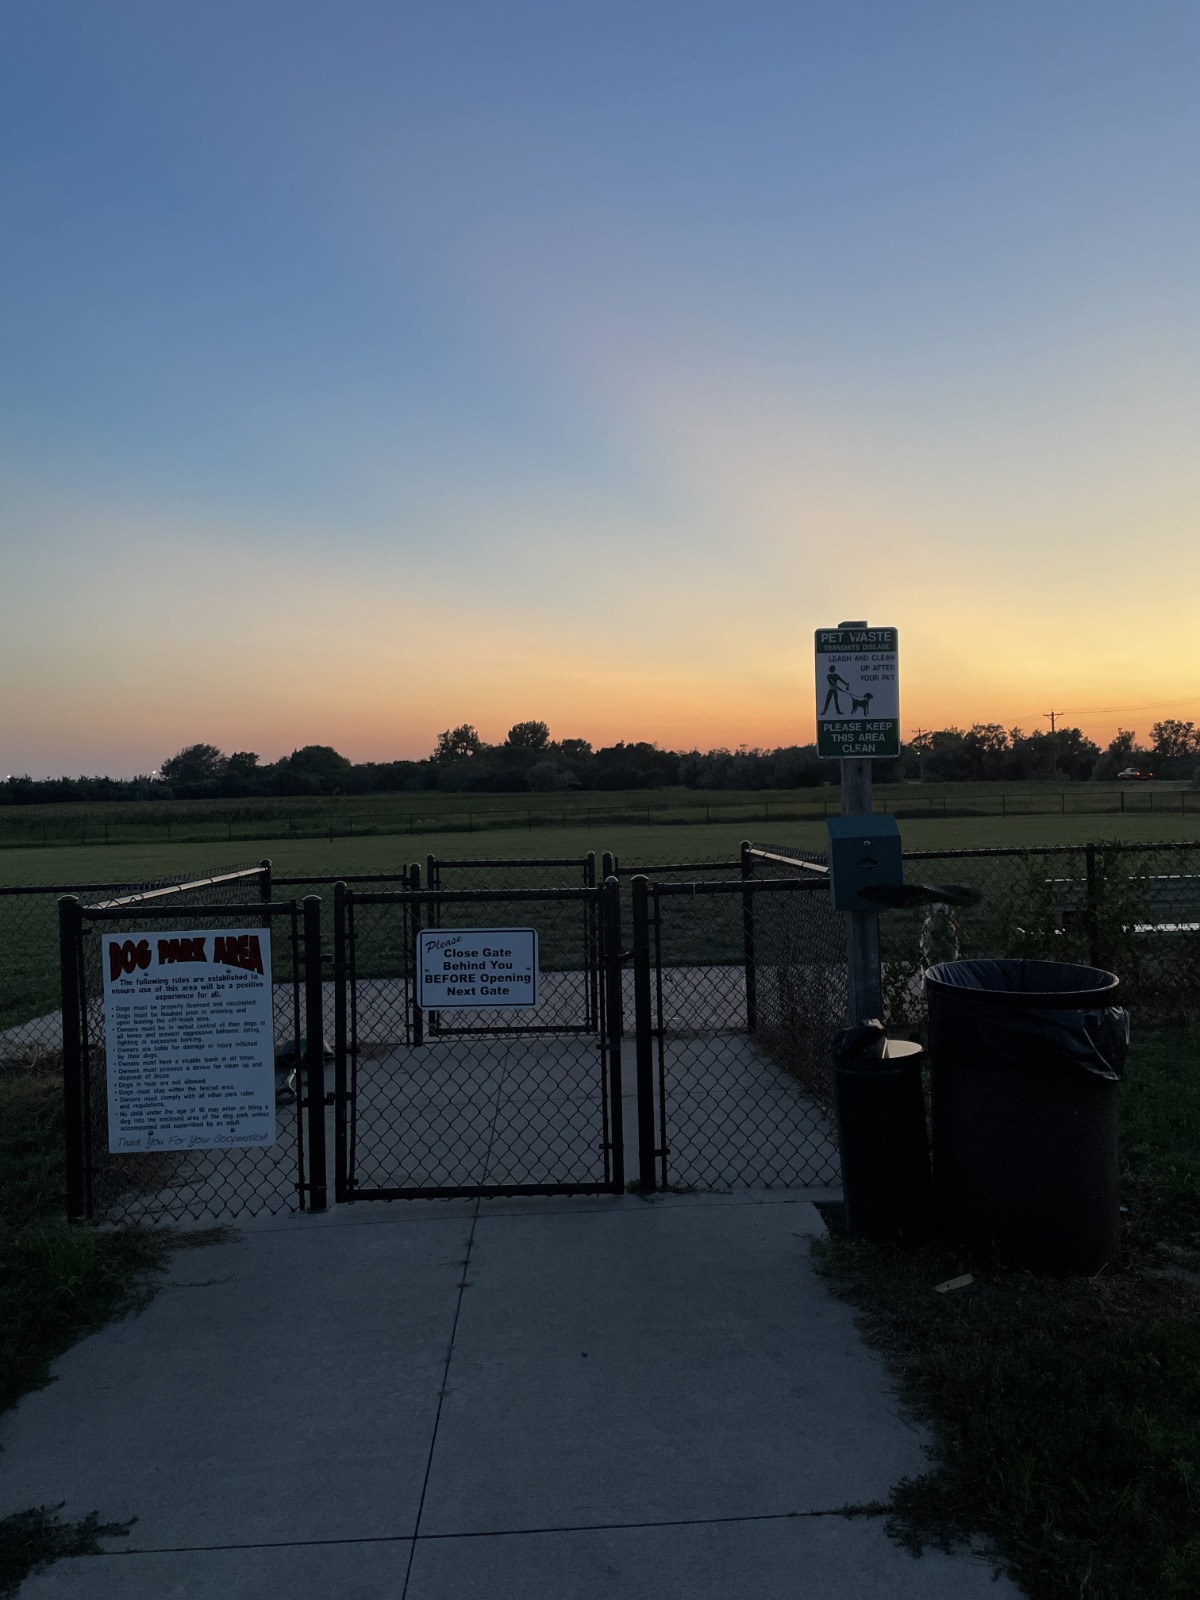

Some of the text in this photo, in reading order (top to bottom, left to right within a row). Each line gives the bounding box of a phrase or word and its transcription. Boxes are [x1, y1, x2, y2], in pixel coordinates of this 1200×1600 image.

[821, 632, 891, 643] PET WASTE
[824, 722, 892, 732] PLEASE KEEP
[832, 733, 885, 742] THIS AREA
[842, 744, 876, 752] CLEAN
[425, 936, 463, 954] Please
[444, 948, 512, 958] Close Gate
[109, 935, 264, 982] DOG PARK AREA
[443, 960, 513, 970] Behind You
[208, 974, 247, 982] established
[425, 973, 531, 984] BEFORE Opening
[447, 986, 510, 996] Next Gate
[155, 993, 194, 1001] experience
[118, 1138, 141, 1147] Thank
[145, 1136, 164, 1149] You
[168, 1136, 185, 1145] For
[188, 1135, 211, 1148] Your
